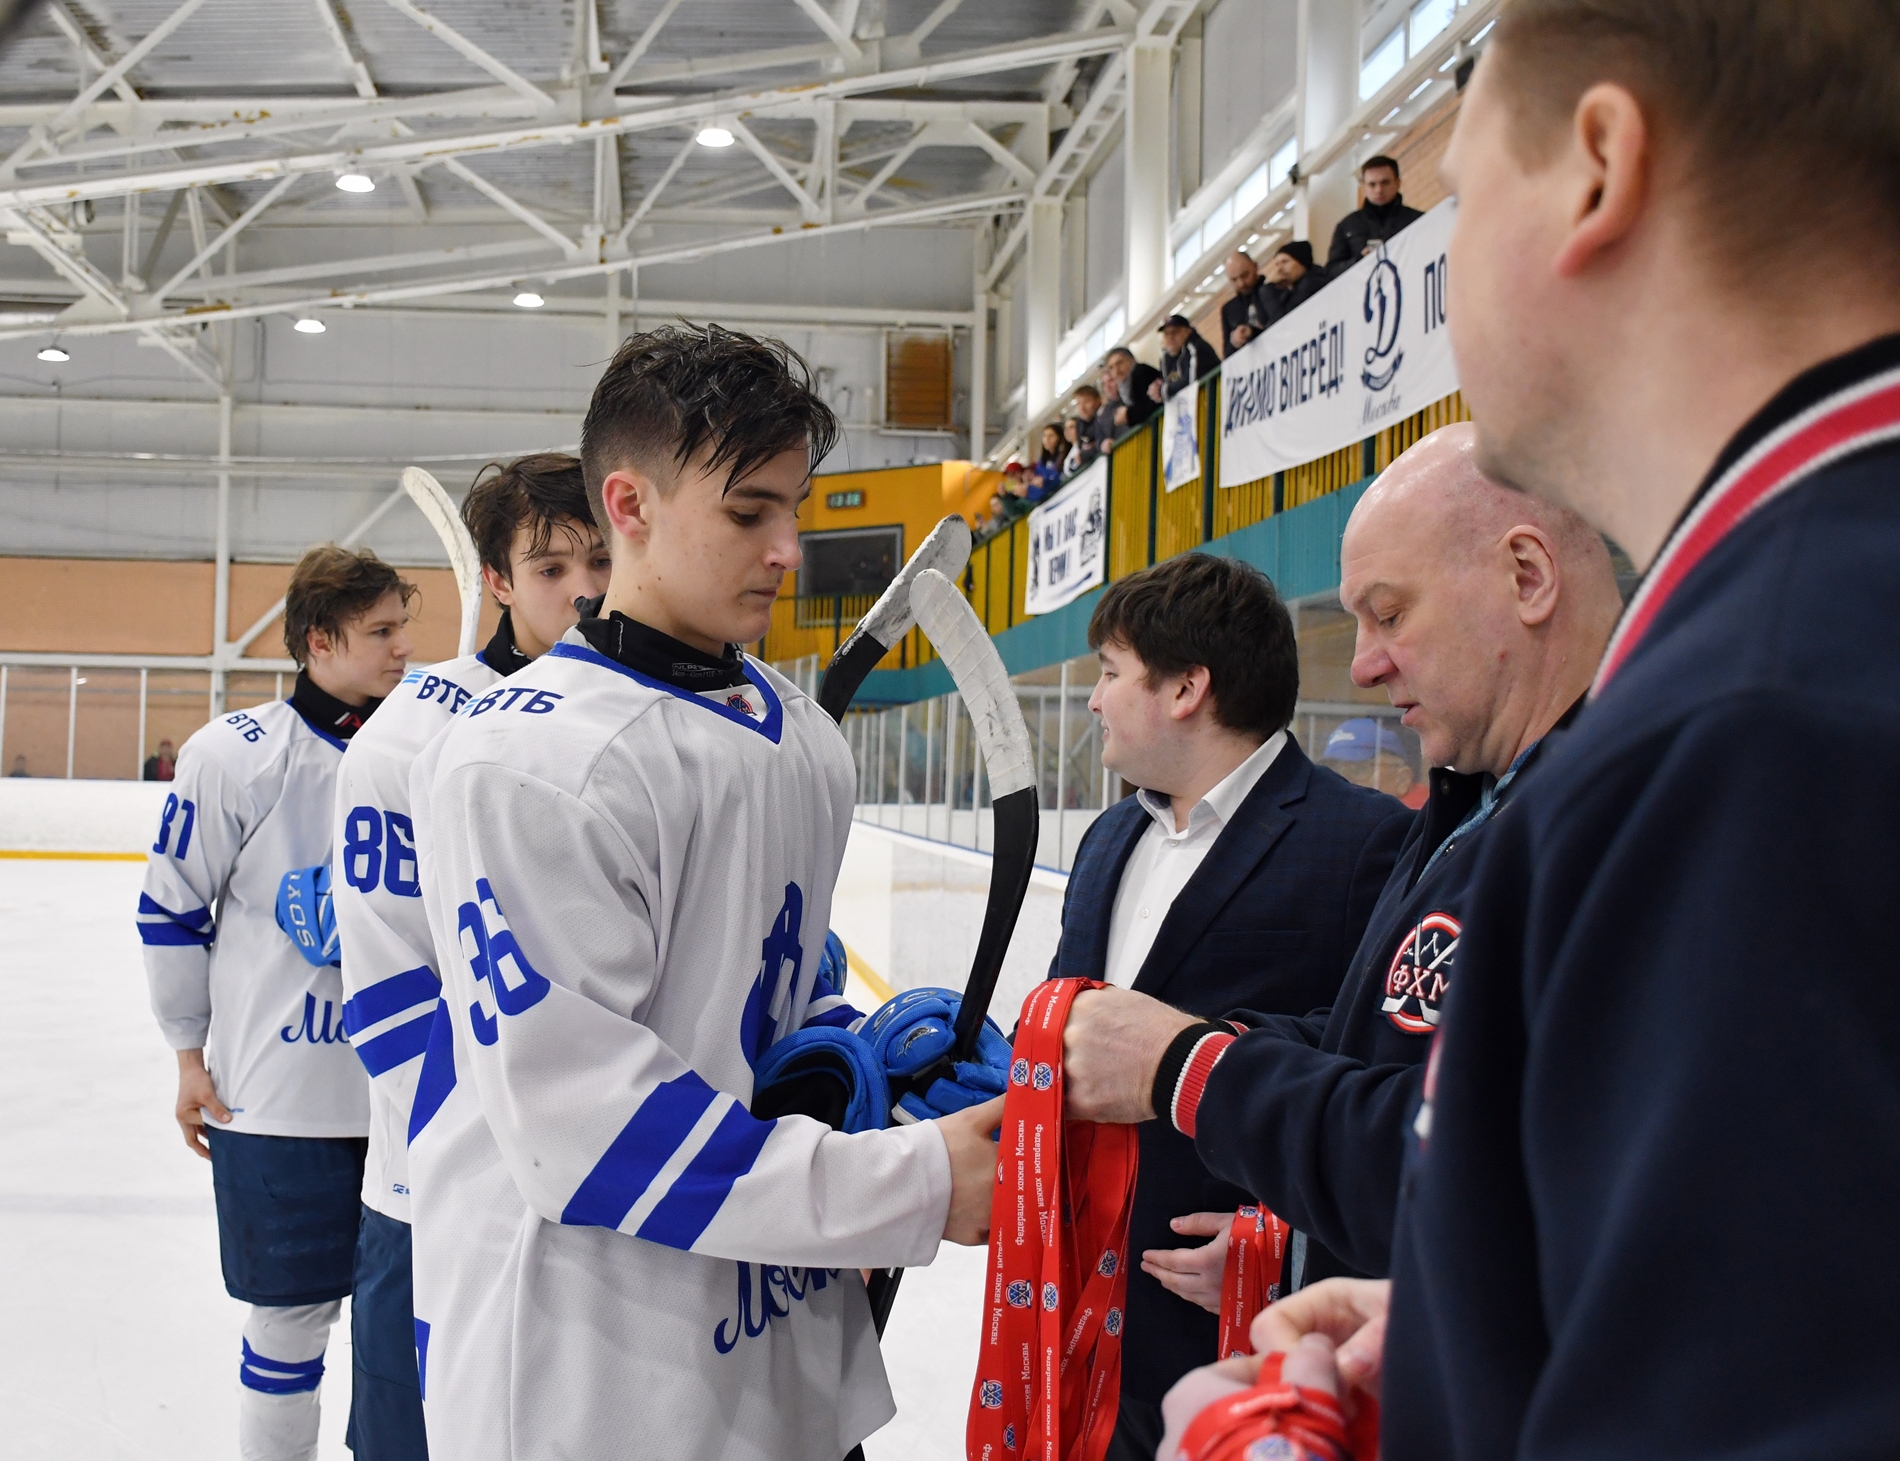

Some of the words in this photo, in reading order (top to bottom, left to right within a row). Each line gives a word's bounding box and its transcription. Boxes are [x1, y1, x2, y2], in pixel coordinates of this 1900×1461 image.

[1279, 320, 1345, 412] ВПЕРЁД!
[416, 675, 474, 714] ВТБ
[468, 687, 565, 719] ВТБ
[226, 713, 267, 743] ВТБ
[343, 805, 424, 898] 86
[1042, 995, 1059, 1029] Москвы
[1015, 1119, 1025, 1157] Москвы
[1032, 1123, 1044, 1174] Федерация
[1016, 1160, 1025, 1192] хоккея
[1035, 1177, 1045, 1208] хоккея
[1014, 1194, 1025, 1246] Федерация
[1237, 1238, 1247, 1275] Федерация
[994, 1272, 1003, 1304] хоккея
[990, 1307, 1003, 1346] Москвы
[1065, 1307, 1093, 1355] Федерация
[1235, 1300, 1244, 1328] Москвы
[1021, 1342, 1031, 1380] Москвы
[1045, 1346, 1053, 1400] Федерация
